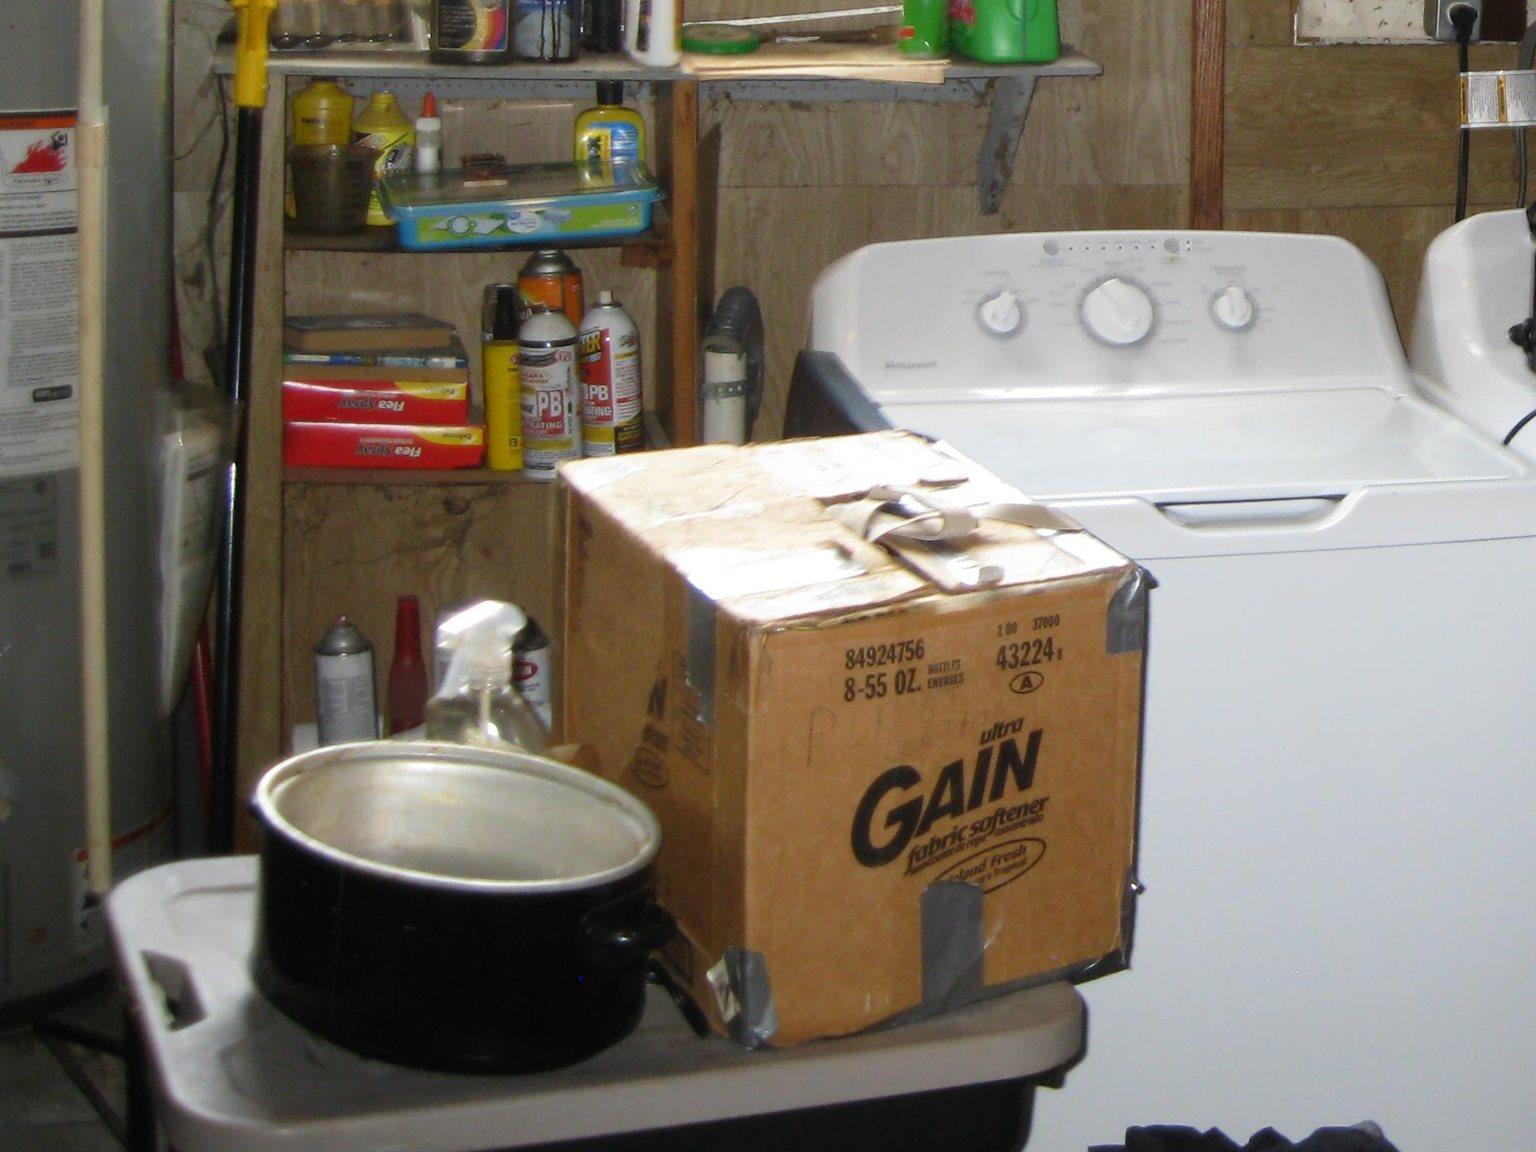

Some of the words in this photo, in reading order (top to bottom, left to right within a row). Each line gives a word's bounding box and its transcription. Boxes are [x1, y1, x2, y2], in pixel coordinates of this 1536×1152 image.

[378, 399, 406, 412] Flea
[395, 445, 423, 458] Flea
[845, 638, 925, 670] 84924756
[996, 637, 1055, 671] 43224
[844, 672, 888, 702] 8-55
[894, 667, 922, 695] OZ.
[979, 716, 1024, 746] ultra
[851, 728, 1043, 868] GAIN
[902, 824, 969, 877] fabric
[968, 795, 1050, 840] softener
